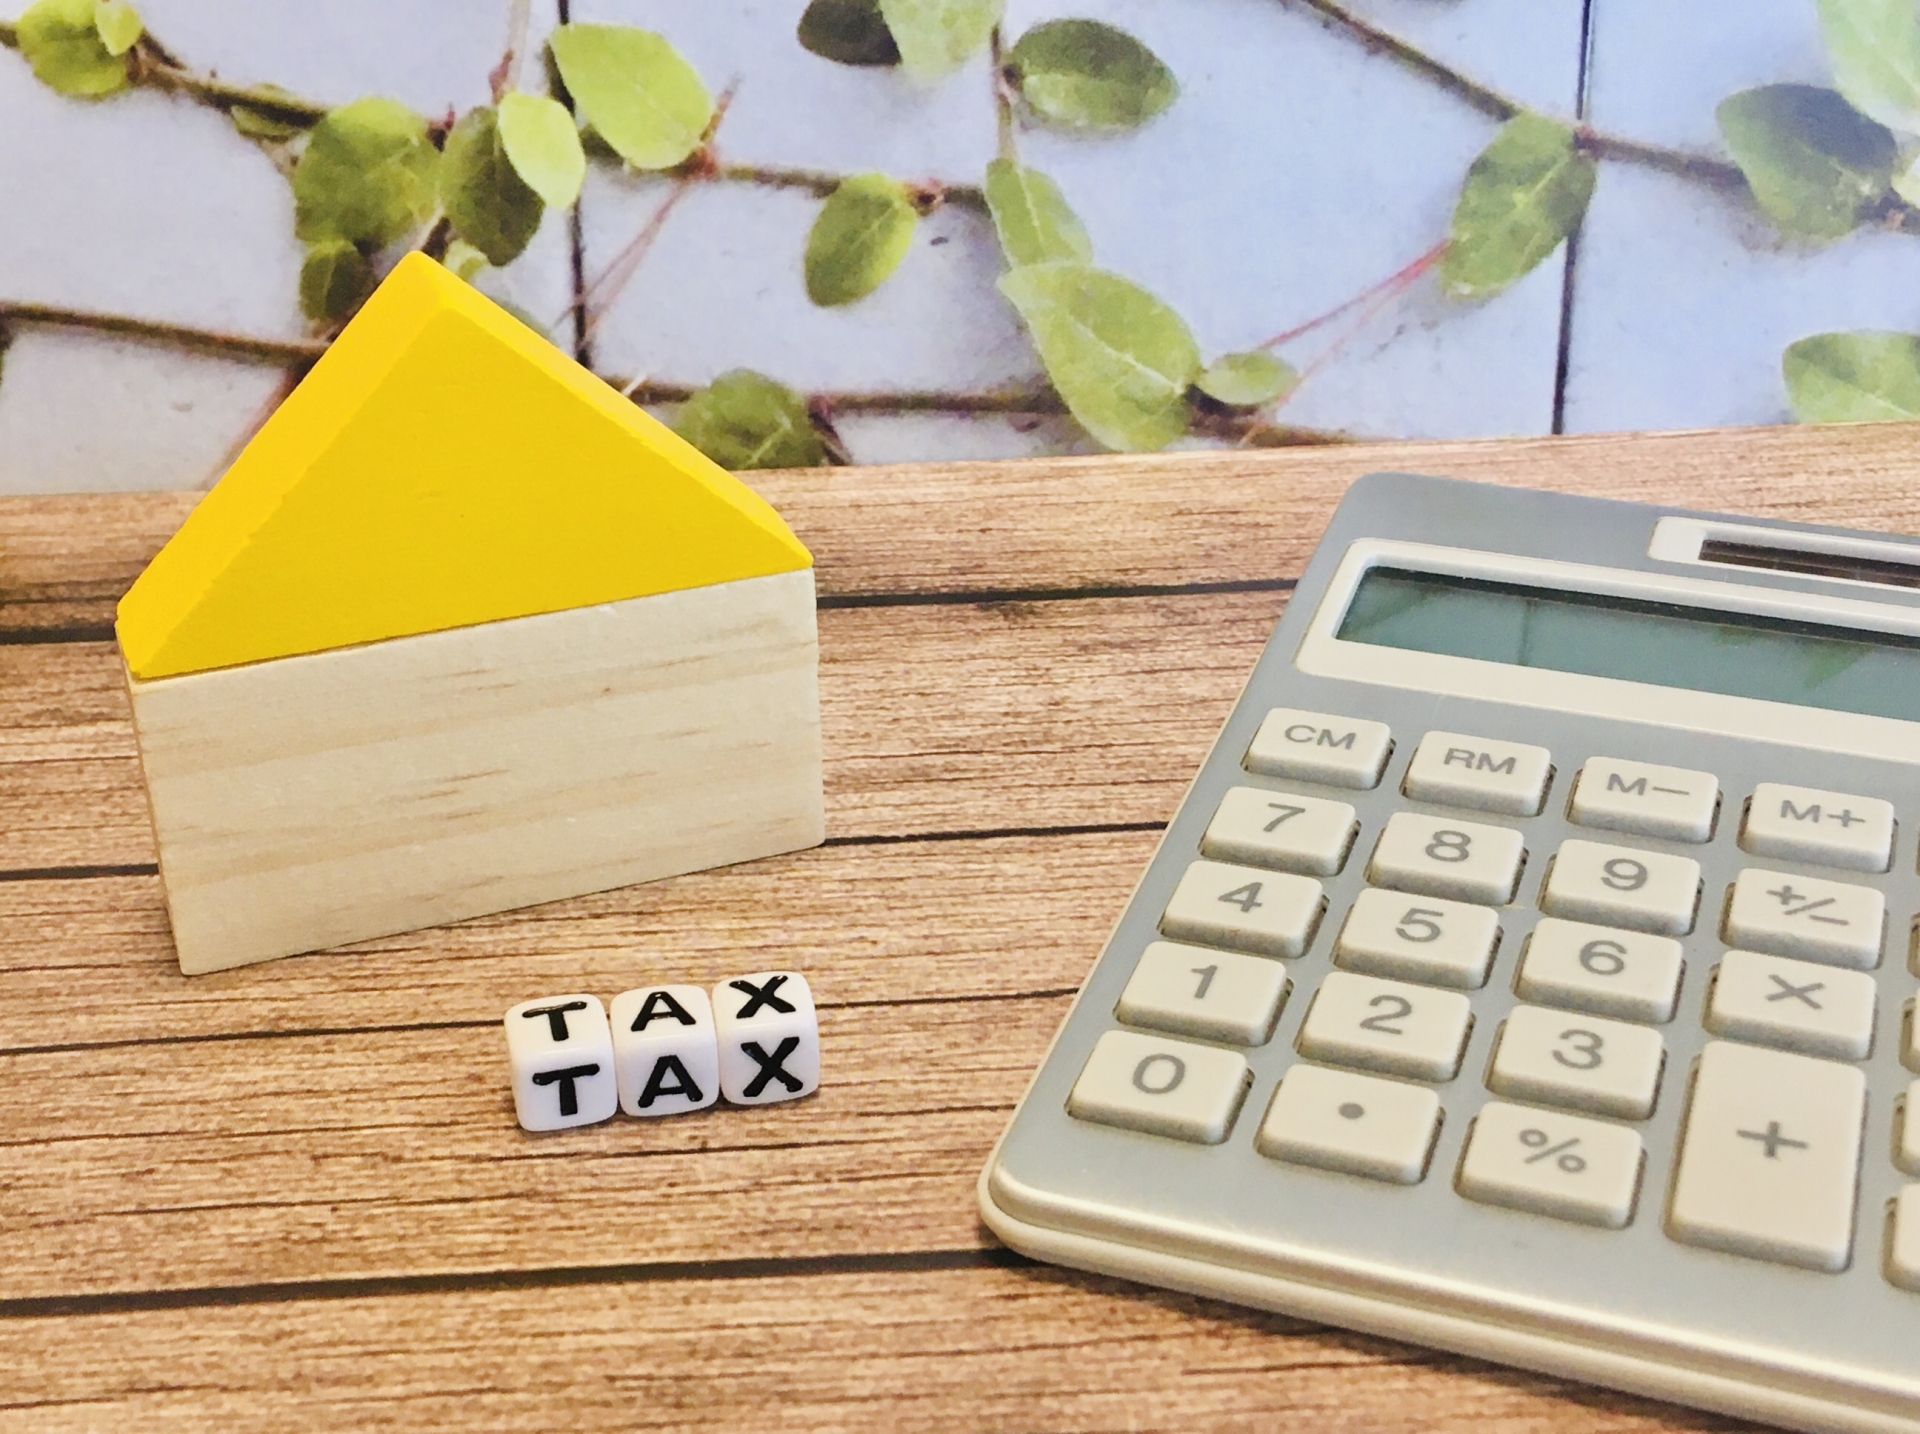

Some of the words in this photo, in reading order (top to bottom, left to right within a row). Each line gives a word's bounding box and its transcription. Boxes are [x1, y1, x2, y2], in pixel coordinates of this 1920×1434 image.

[1284, 724, 1357, 750] CM
[1443, 747, 1518, 775] RM
[1262, 802, 1306, 833] 7
[1779, 799, 1867, 828] M+
[1424, 829, 1472, 863] 8
[1600, 857, 1649, 892] 9
[1218, 880, 1264, 913] 4
[1394, 907, 1445, 943] 5
[1578, 939, 1628, 976] 6
[1190, 963, 1218, 1000] 1
[521, 974, 796, 1042] TAX
[1358, 993, 1413, 1036] 2
[1551, 1028, 1605, 1070] 3
[531, 1036, 804, 1117] TAX
[1131, 1052, 1186, 1095] 0
[1518, 1128, 1588, 1174] %
